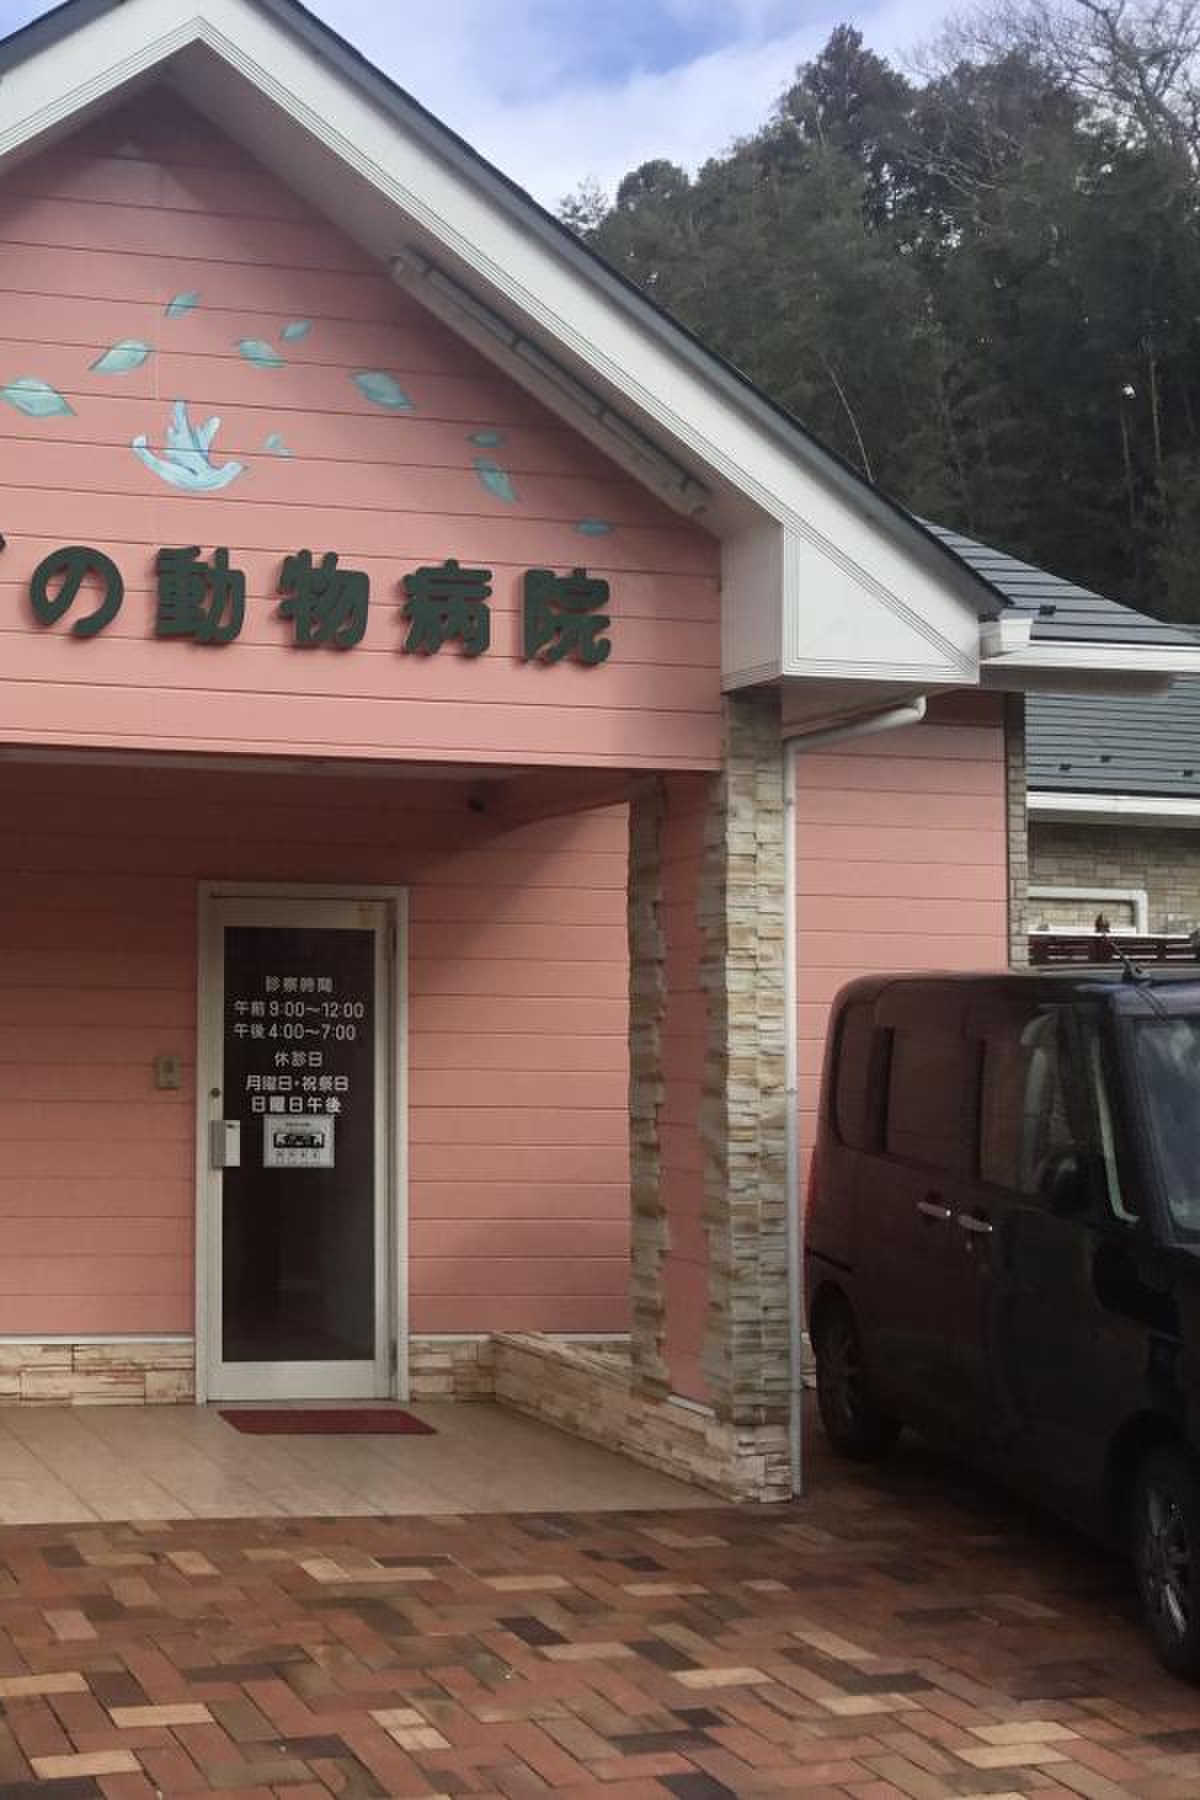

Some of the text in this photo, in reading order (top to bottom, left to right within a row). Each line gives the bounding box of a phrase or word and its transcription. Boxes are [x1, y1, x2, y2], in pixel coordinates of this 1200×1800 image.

[274, 1050, 323, 1068] 休診日
[251, 1095, 342, 1113] 日曜日午後
